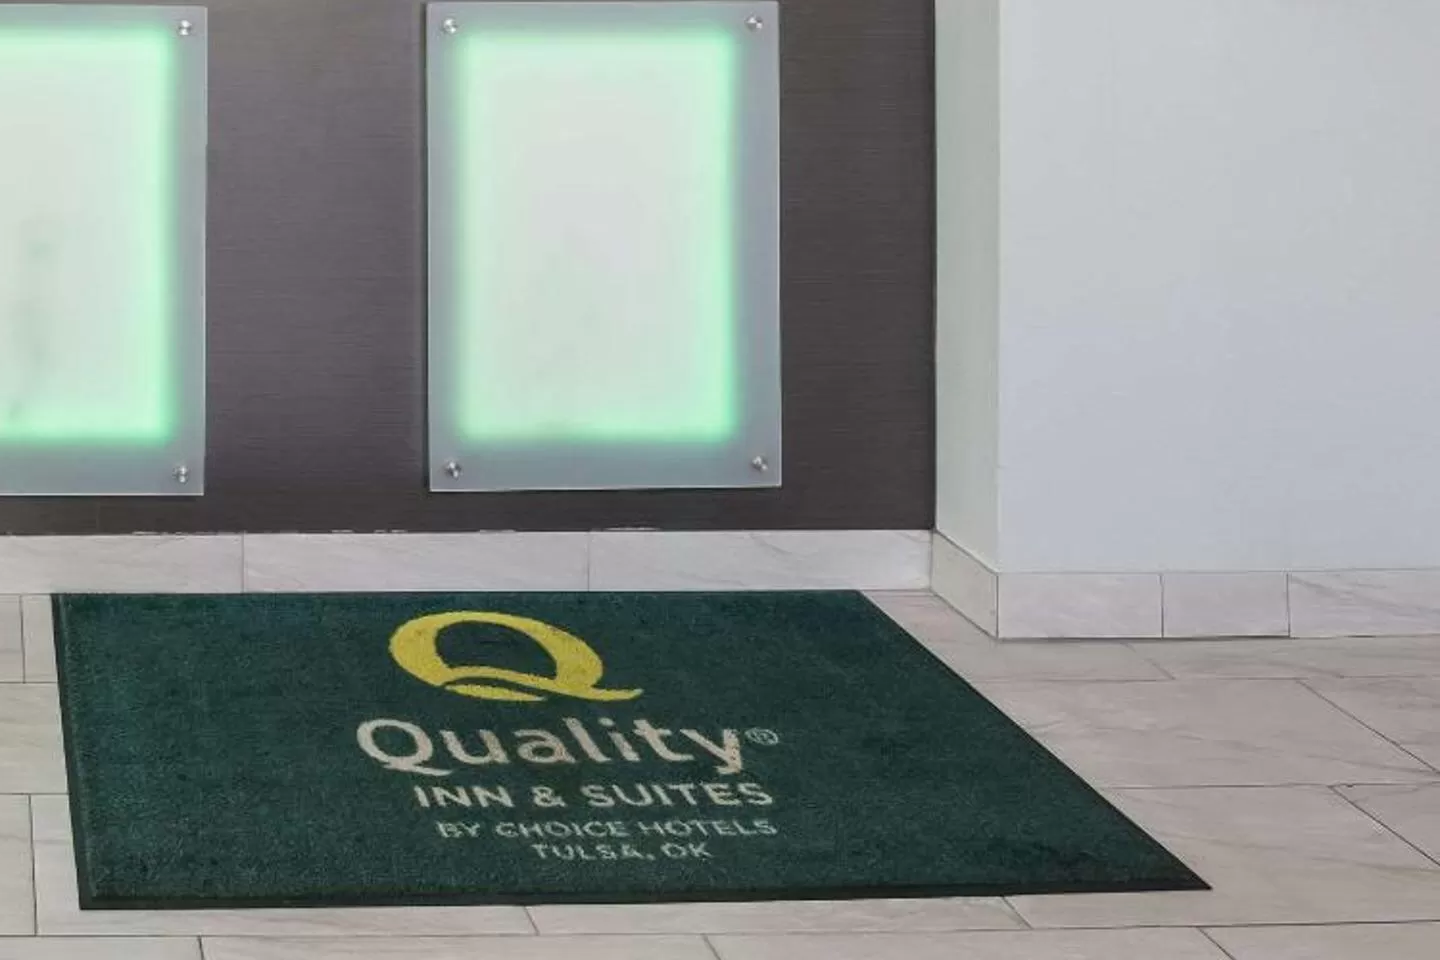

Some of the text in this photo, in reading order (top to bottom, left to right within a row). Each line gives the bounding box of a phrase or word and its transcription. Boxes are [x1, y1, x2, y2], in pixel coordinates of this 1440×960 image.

[388, 610, 645, 702] Q
[412, 782, 774, 809] INN & SUITES
[436, 819, 778, 839] BY CHOICE HOTELS
[661, 842, 714, 860] OK
